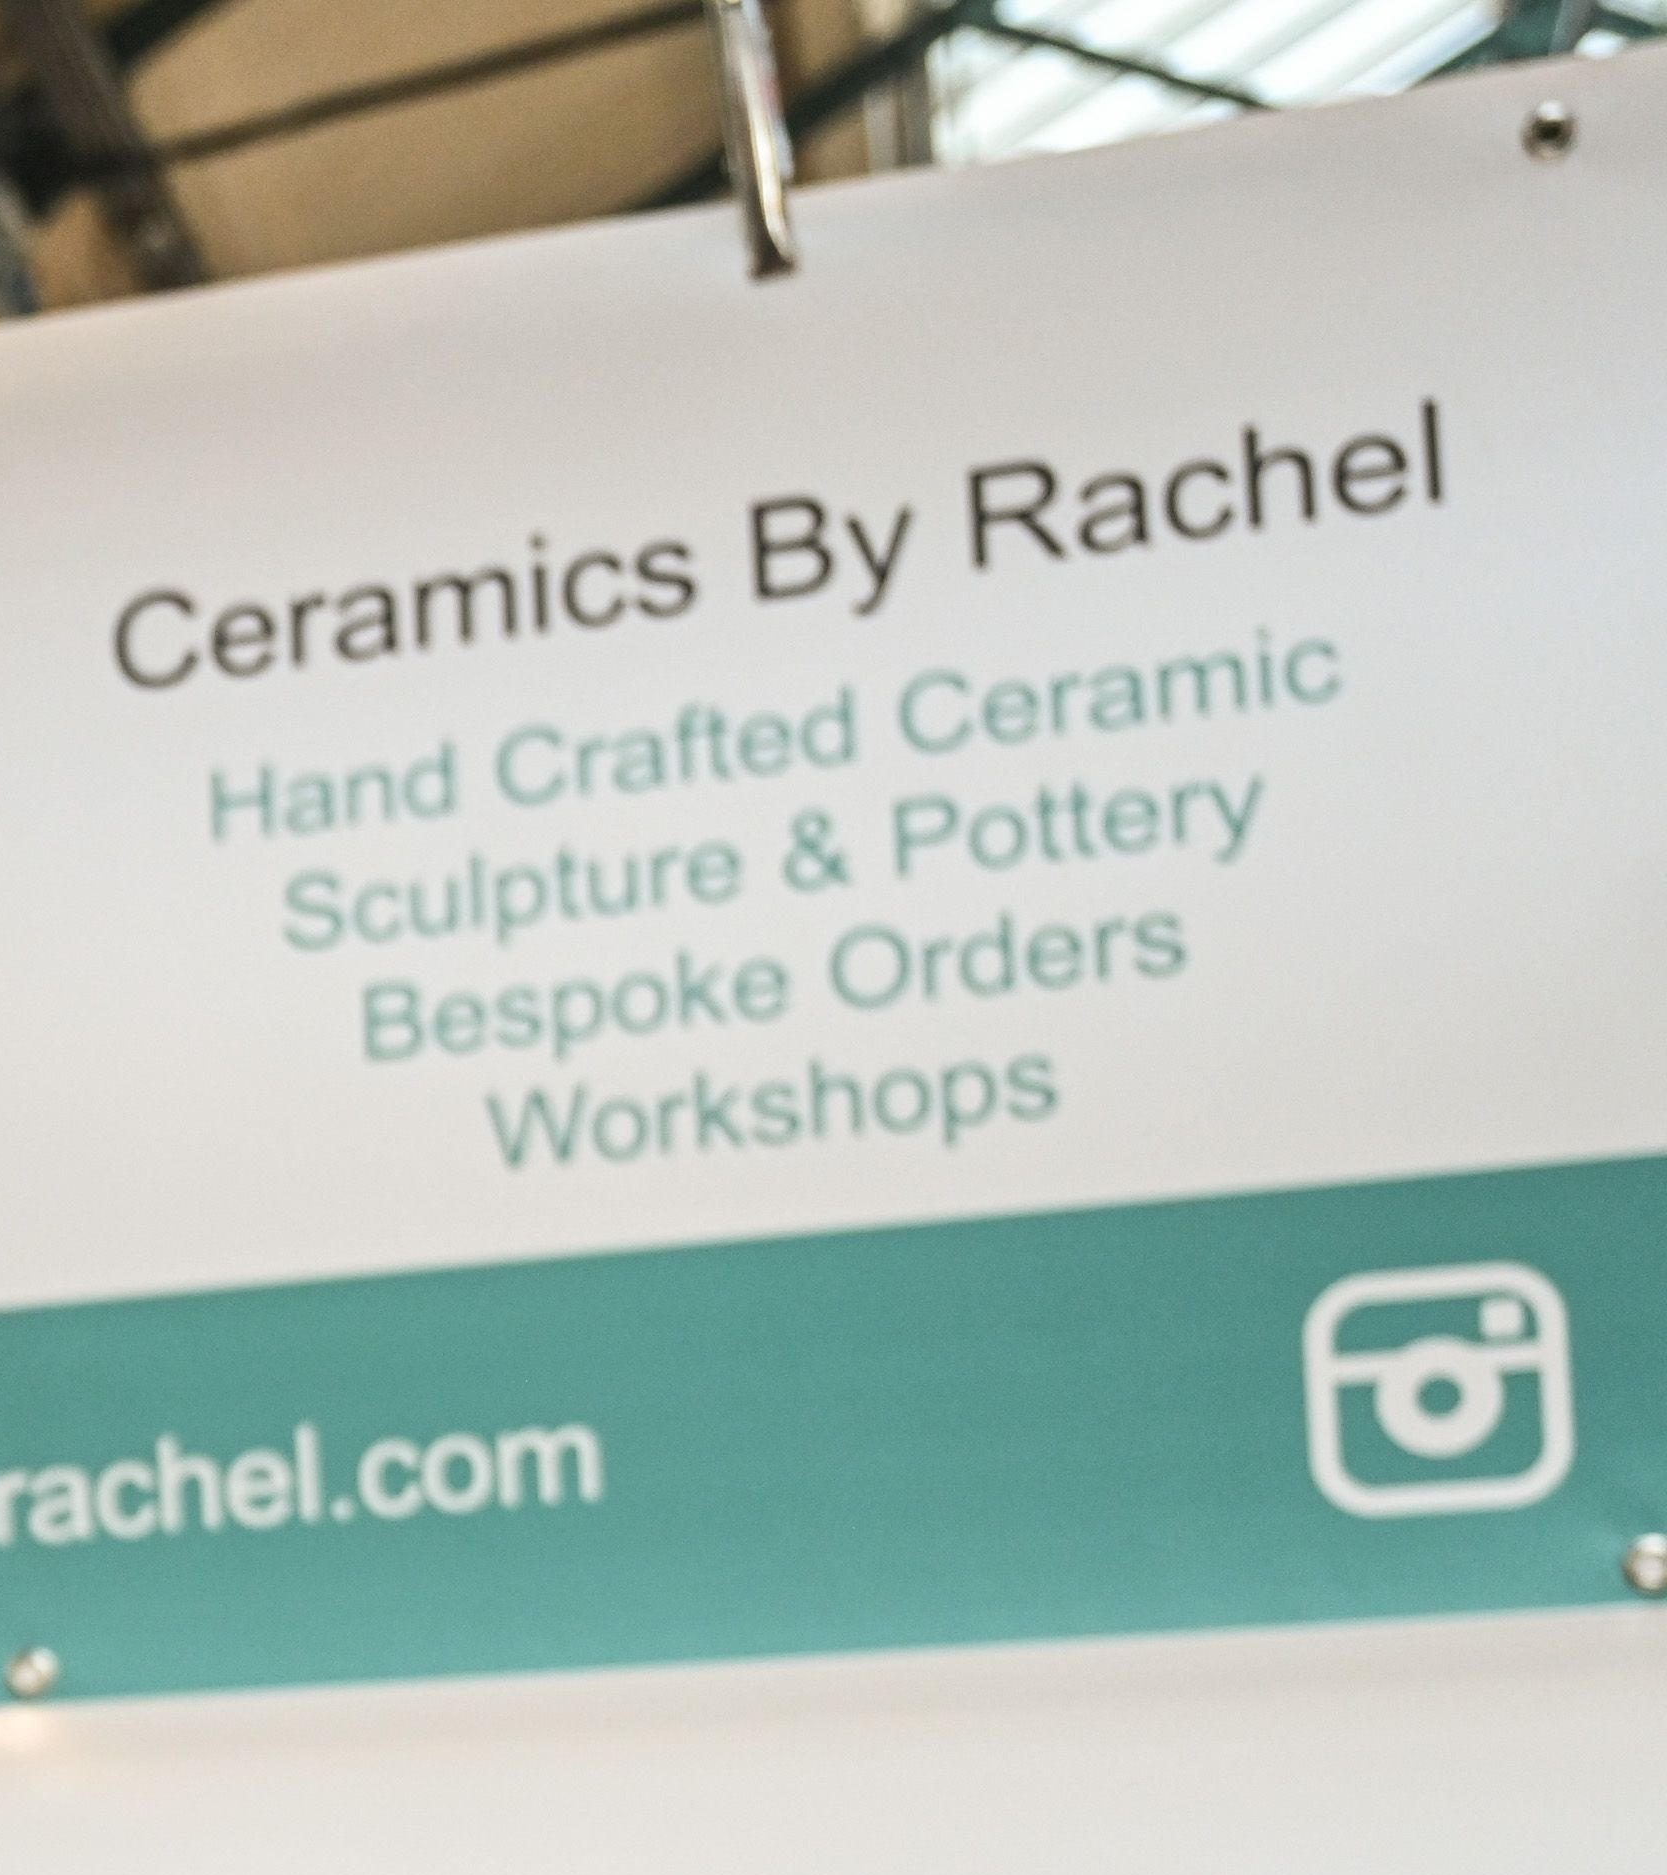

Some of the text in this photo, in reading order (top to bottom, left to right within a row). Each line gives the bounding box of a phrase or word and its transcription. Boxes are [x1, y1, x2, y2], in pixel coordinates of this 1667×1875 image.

[112, 397, 1447, 692] Ceramics By Rachel
[208, 627, 1344, 844] Hand Crafted Ceramic
[281, 770, 1265, 952] Sculpture & Pottery
[360, 908, 1189, 1065] Bespoke Orders
[484, 1051, 1061, 1171] Workshops
